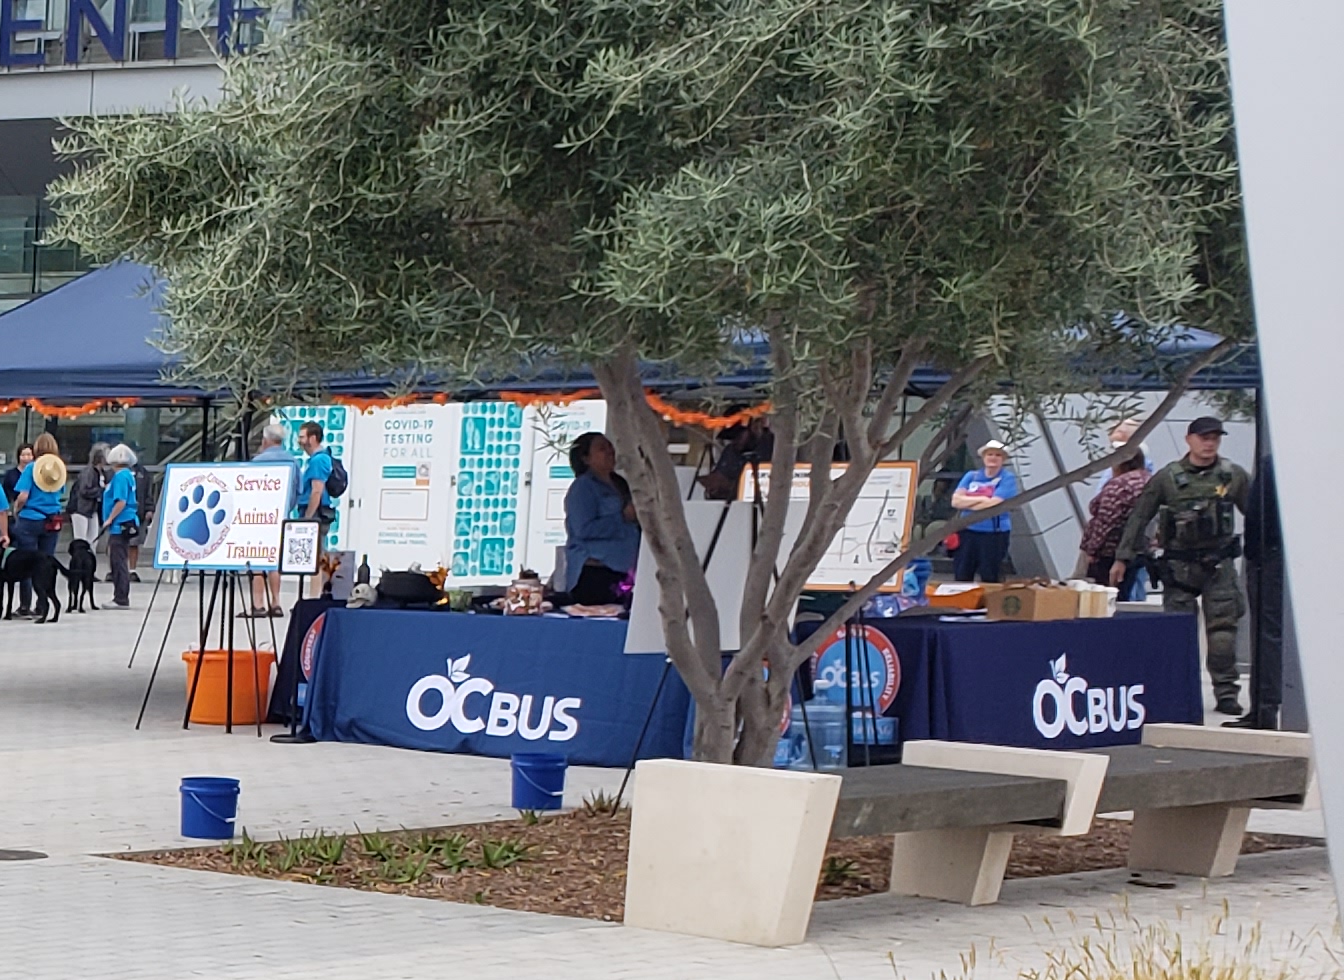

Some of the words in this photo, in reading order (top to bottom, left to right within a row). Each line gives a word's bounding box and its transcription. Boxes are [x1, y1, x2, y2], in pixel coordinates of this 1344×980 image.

[384, 419, 433, 430] COVID-19
[383, 433, 433, 444] TESTING
[383, 447, 407, 458] FOR
[411, 447, 433, 458] ALL
[235, 474, 281, 492] Service
[232, 508, 279, 525] Animal
[226, 541, 277, 563] Training
